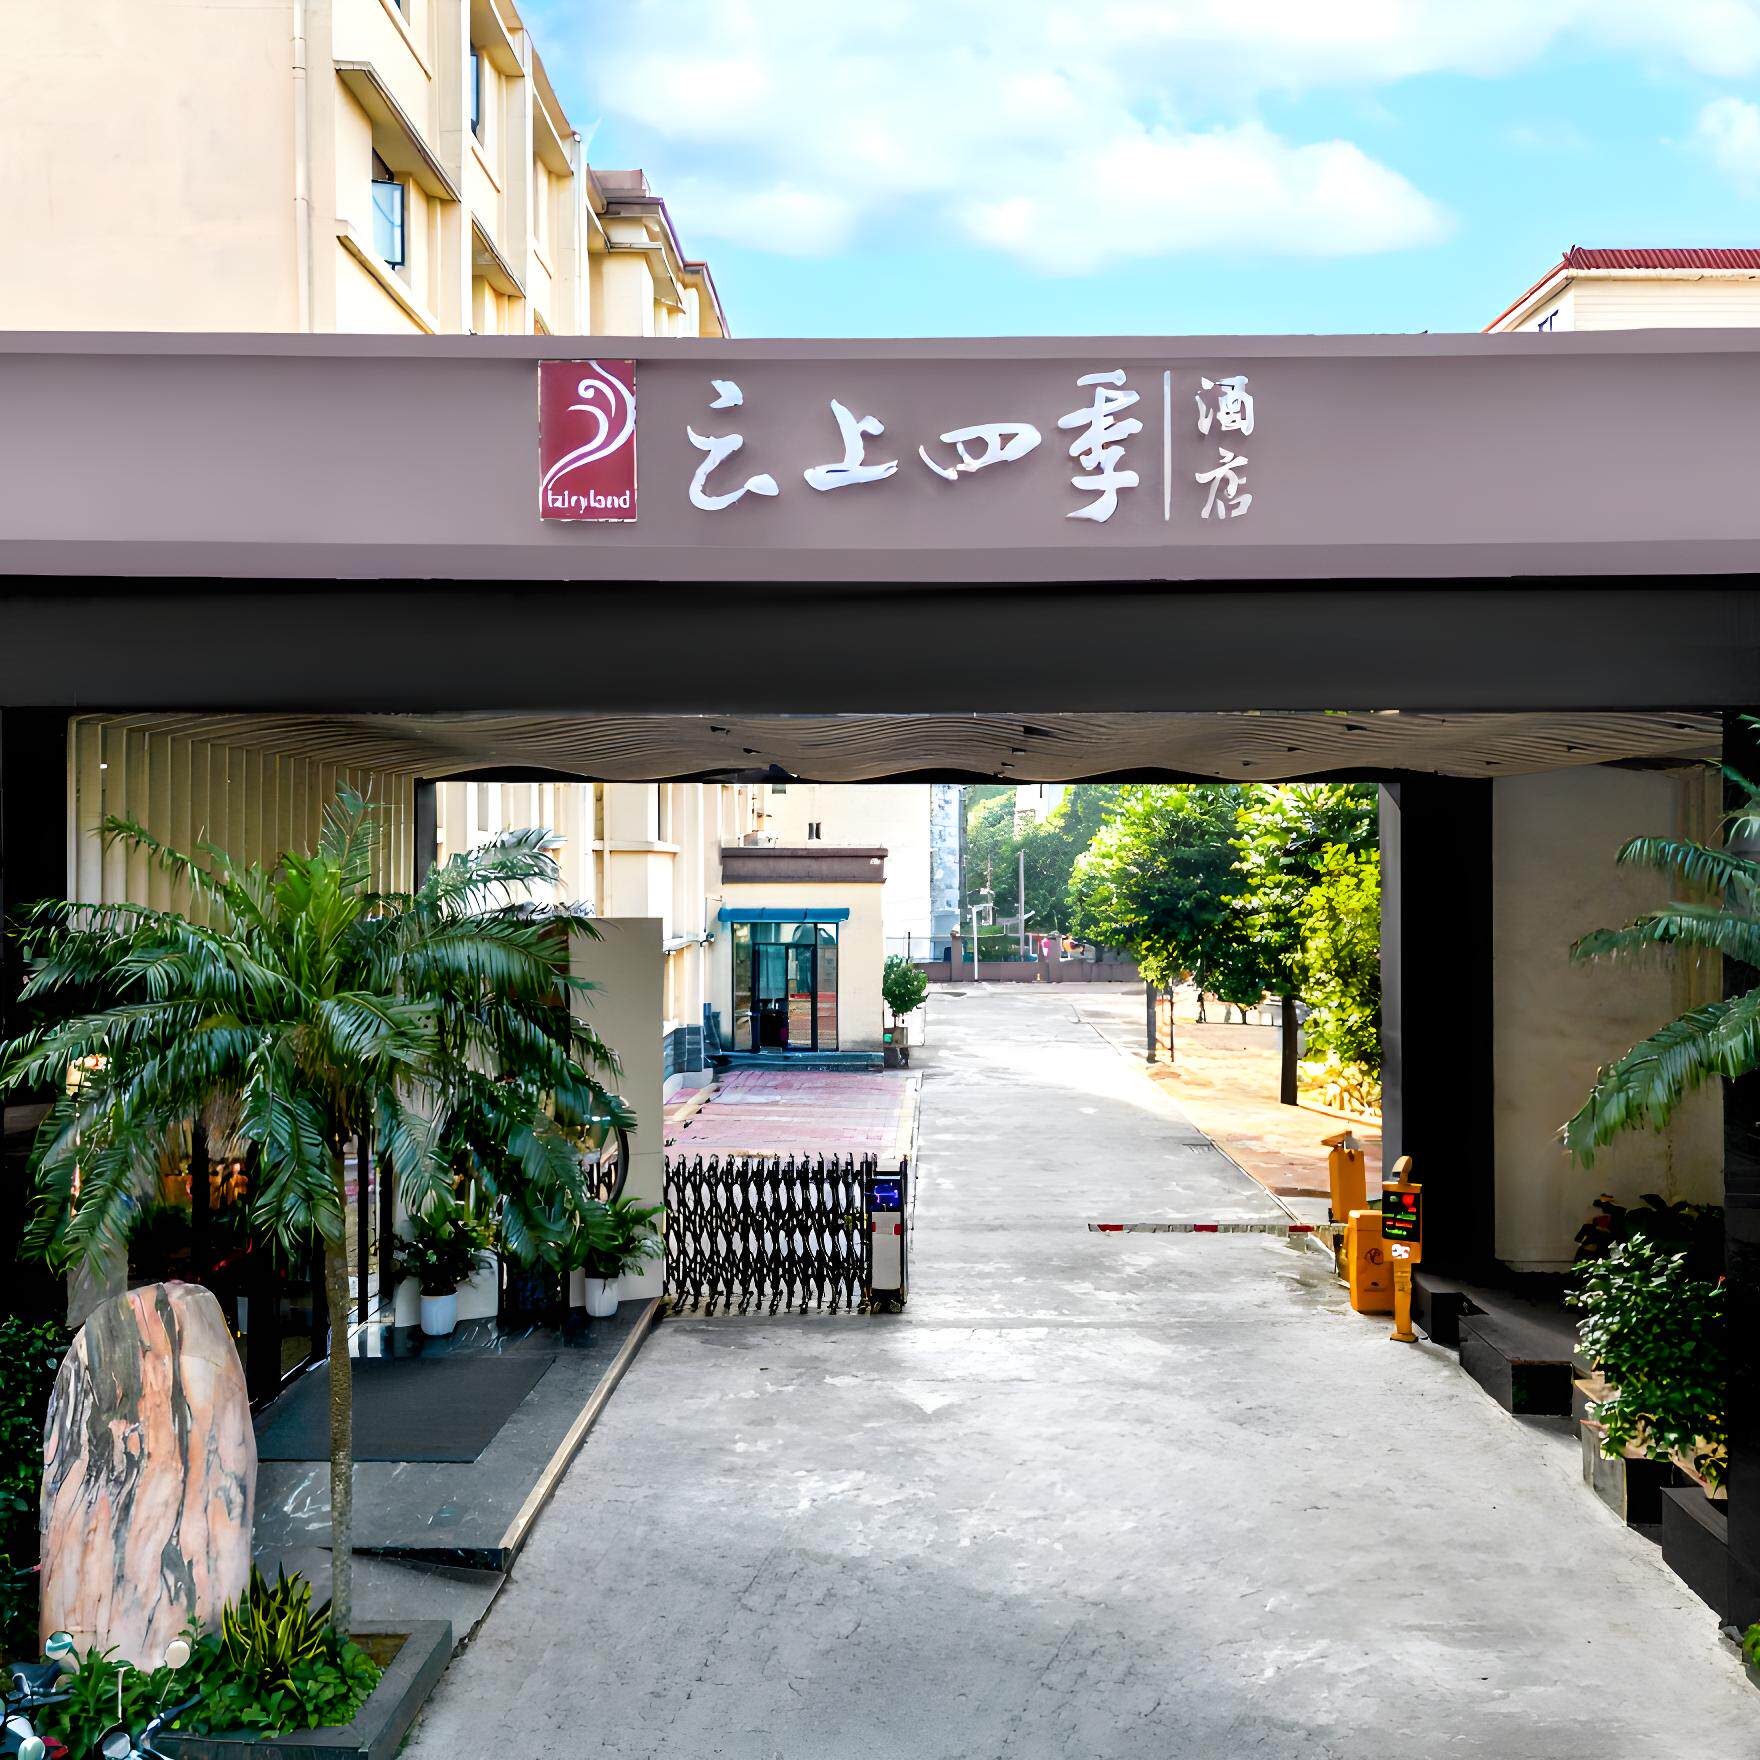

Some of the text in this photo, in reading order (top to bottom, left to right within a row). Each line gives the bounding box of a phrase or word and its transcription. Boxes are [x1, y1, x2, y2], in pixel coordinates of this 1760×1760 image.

[686, 368, 1144, 523] 云上四季
[1194, 375, 1255, 520] 酒店
